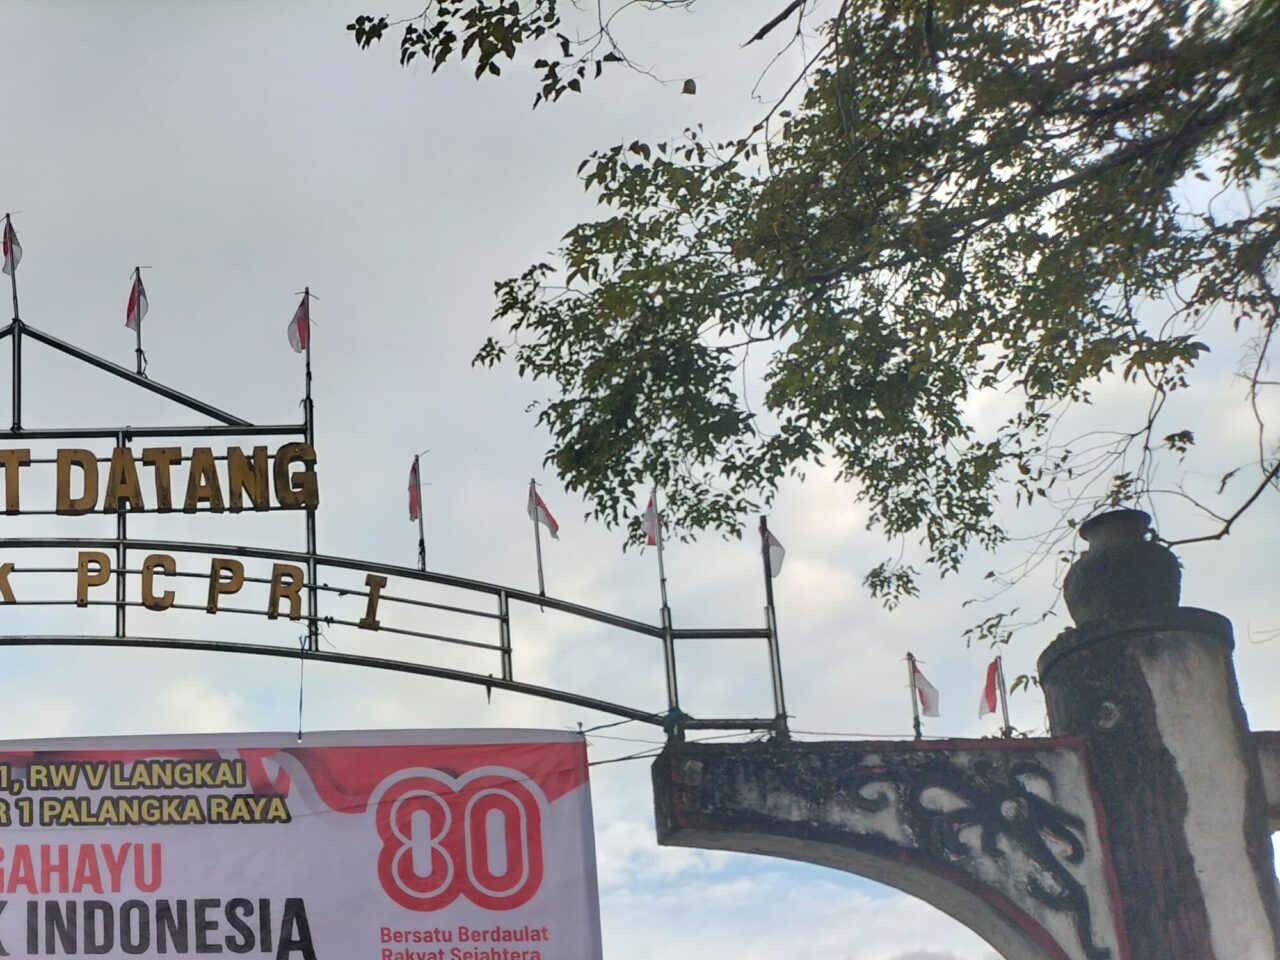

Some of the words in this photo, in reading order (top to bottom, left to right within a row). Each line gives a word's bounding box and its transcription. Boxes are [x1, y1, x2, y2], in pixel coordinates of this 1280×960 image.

[55, 442, 319, 516] DATANG
[27, 762, 79, 791] RW
[81, 762, 110, 791] V
[112, 759, 246, 788] LANGKAI
[15, 797, 33, 826] 1
[40, 796, 205, 826] PALANGKA
[207, 794, 291, 824] RAYA
[375, 775, 545, 912] 80
[380, 925, 452, 944] Bersatu
[458, 924, 549, 943] Berdaulat
